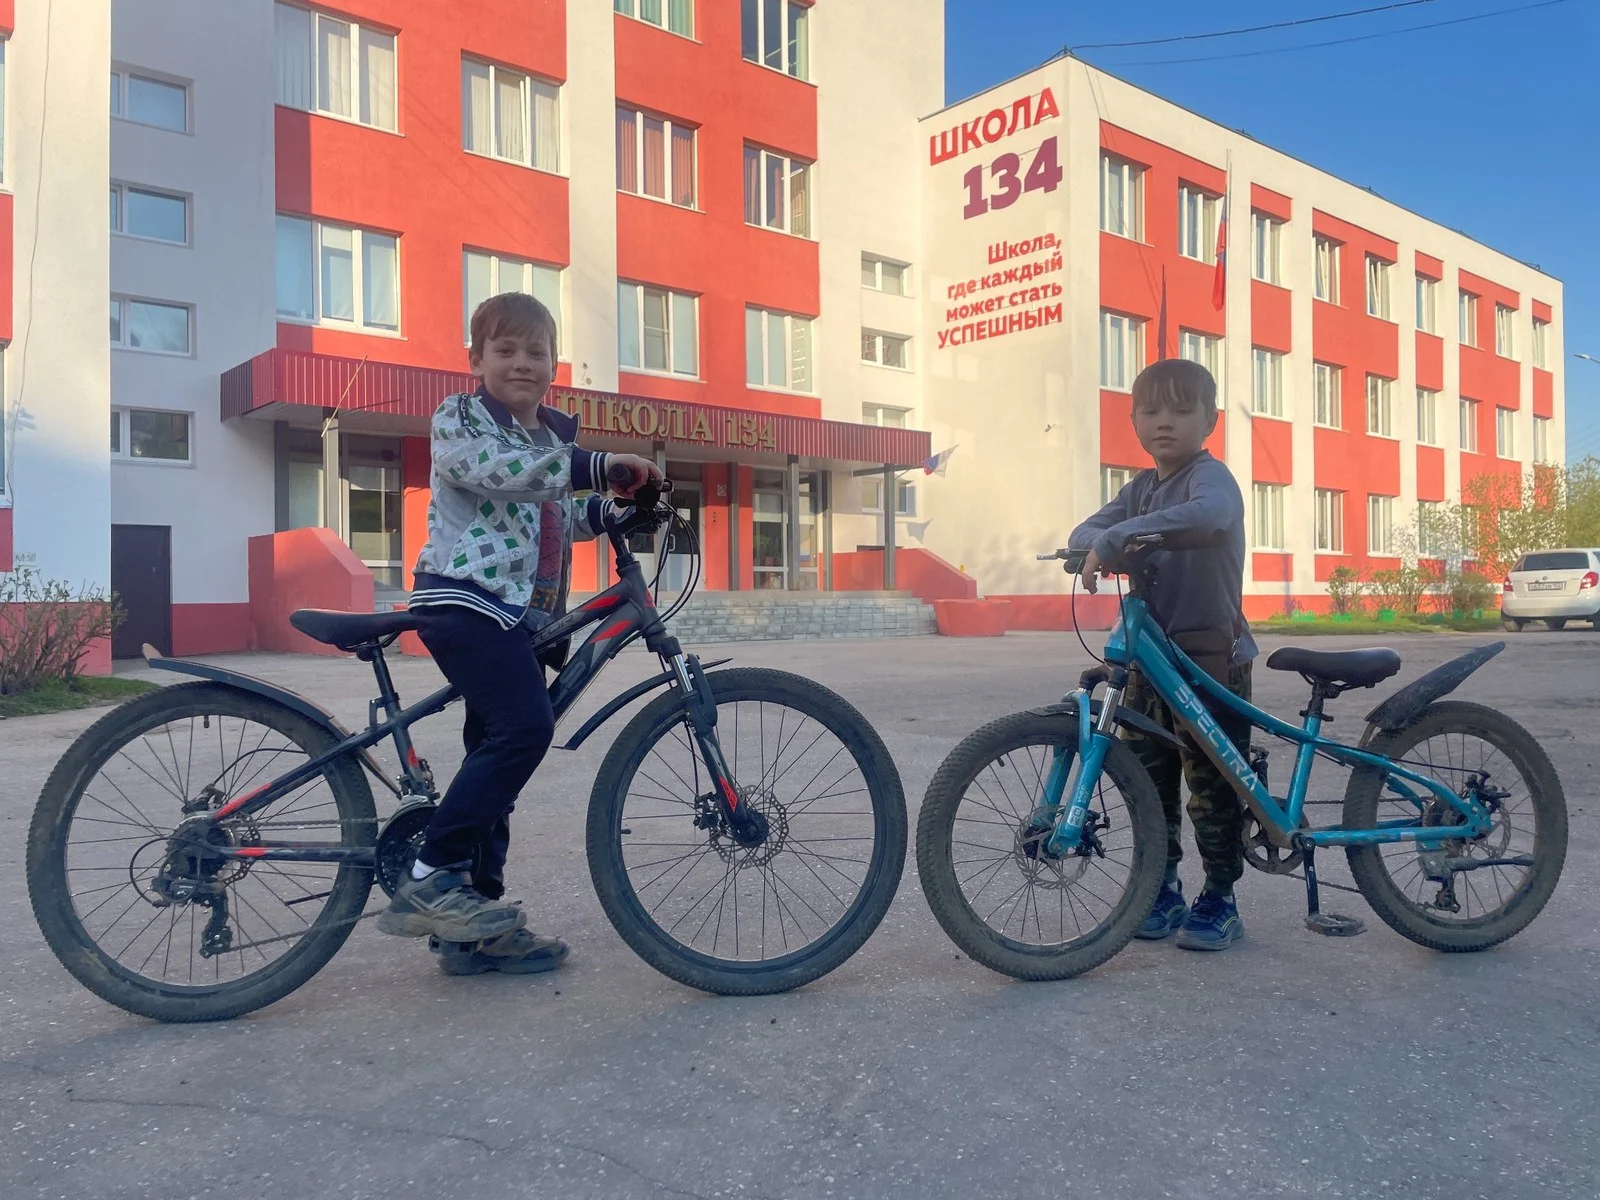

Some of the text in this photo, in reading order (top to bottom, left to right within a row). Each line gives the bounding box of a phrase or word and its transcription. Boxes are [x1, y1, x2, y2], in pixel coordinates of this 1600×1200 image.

[930, 87, 1060, 167] ШКОЛА
[963, 135, 1063, 220] 134
[988, 232, 1062, 265] Школа,
[947, 251, 1063, 300] где каждый
[937, 303, 1063, 350] УСПЕШНЫМ
[946, 282, 1063, 323] может стать
[556, 393, 715, 443] ШКОЛА
[725, 415, 776, 449] 134
[1174, 682, 1258, 792] SPECTRA
